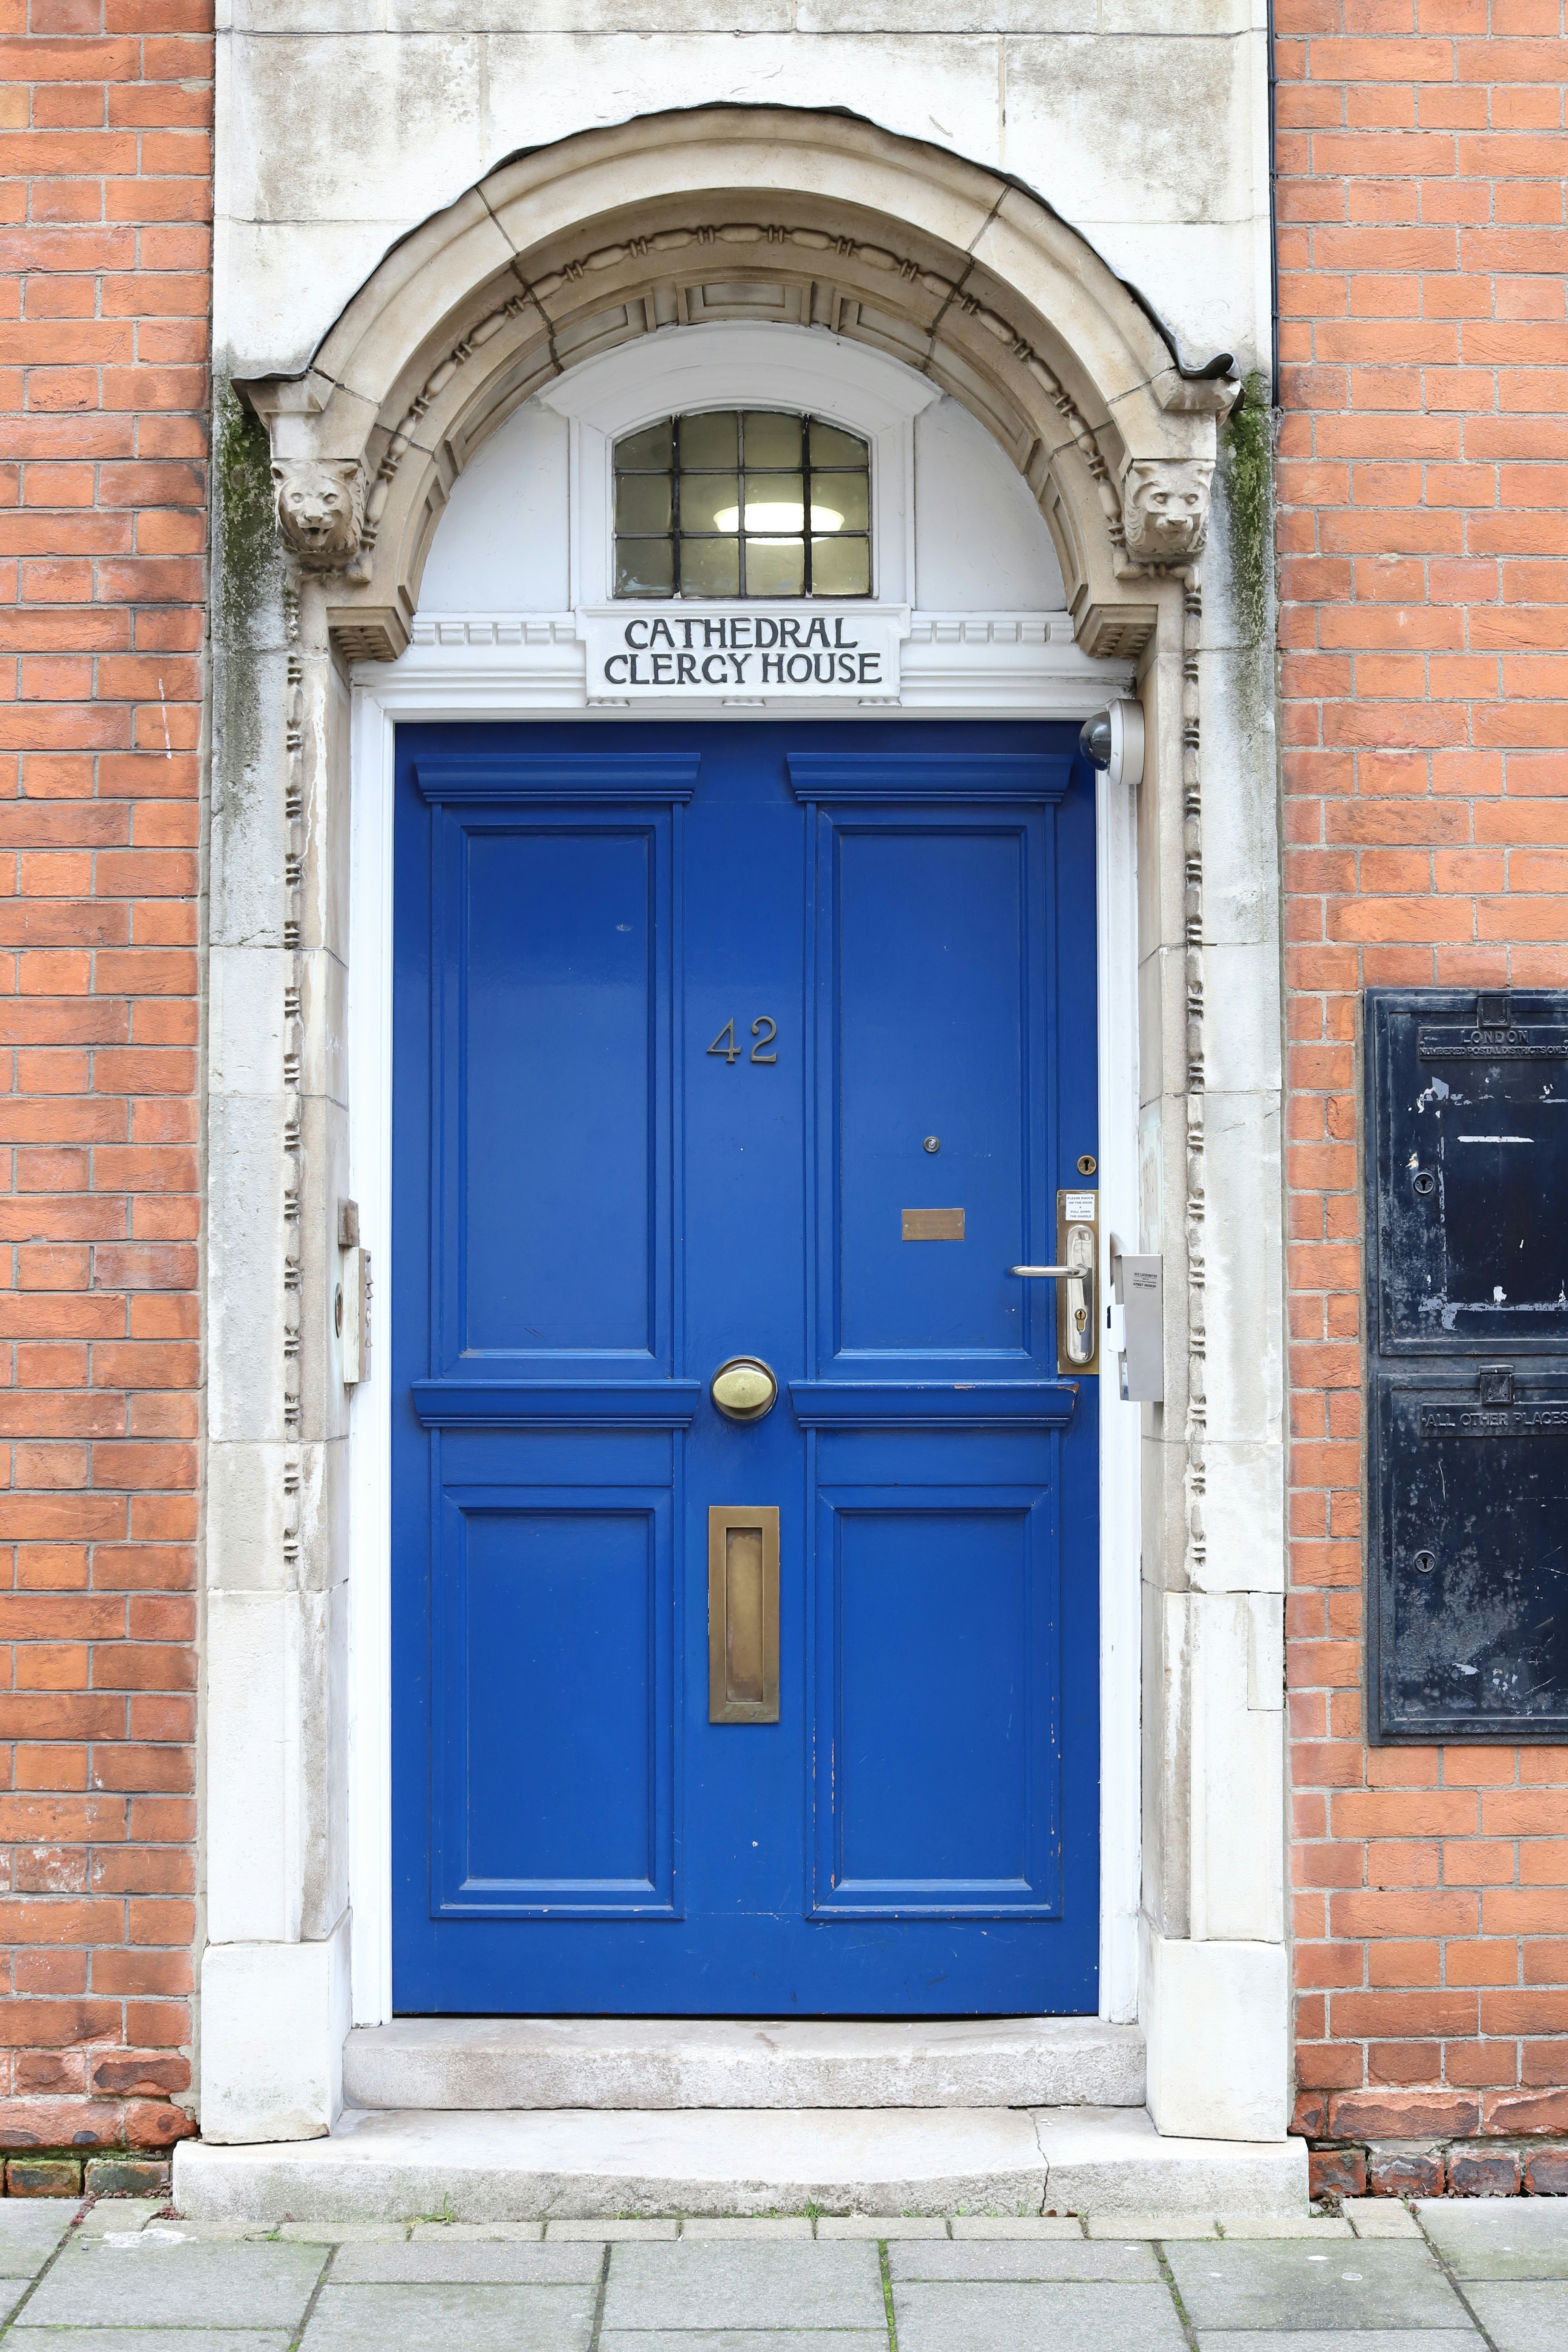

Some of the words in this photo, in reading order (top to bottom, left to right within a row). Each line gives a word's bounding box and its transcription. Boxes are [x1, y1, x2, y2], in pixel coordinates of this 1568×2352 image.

[625, 617, 858, 649] CATHEDRAL
[604, 653, 752, 684] CLERGY
[761, 652, 882, 684] HOUSE
[706, 1016, 777, 1063] 42
[1460, 1030, 1529, 1044] LONDON
[1467, 1046, 1501, 1055] POSTAL
[1501, 1046, 1546, 1055] DISTRICTS
[1546, 1046, 1568, 1054] ONLY
[1426, 1413, 1456, 1427] ALL
[1460, 1413, 1508, 1427] OTHER
[1513, 1411, 1568, 1426] PLACES
